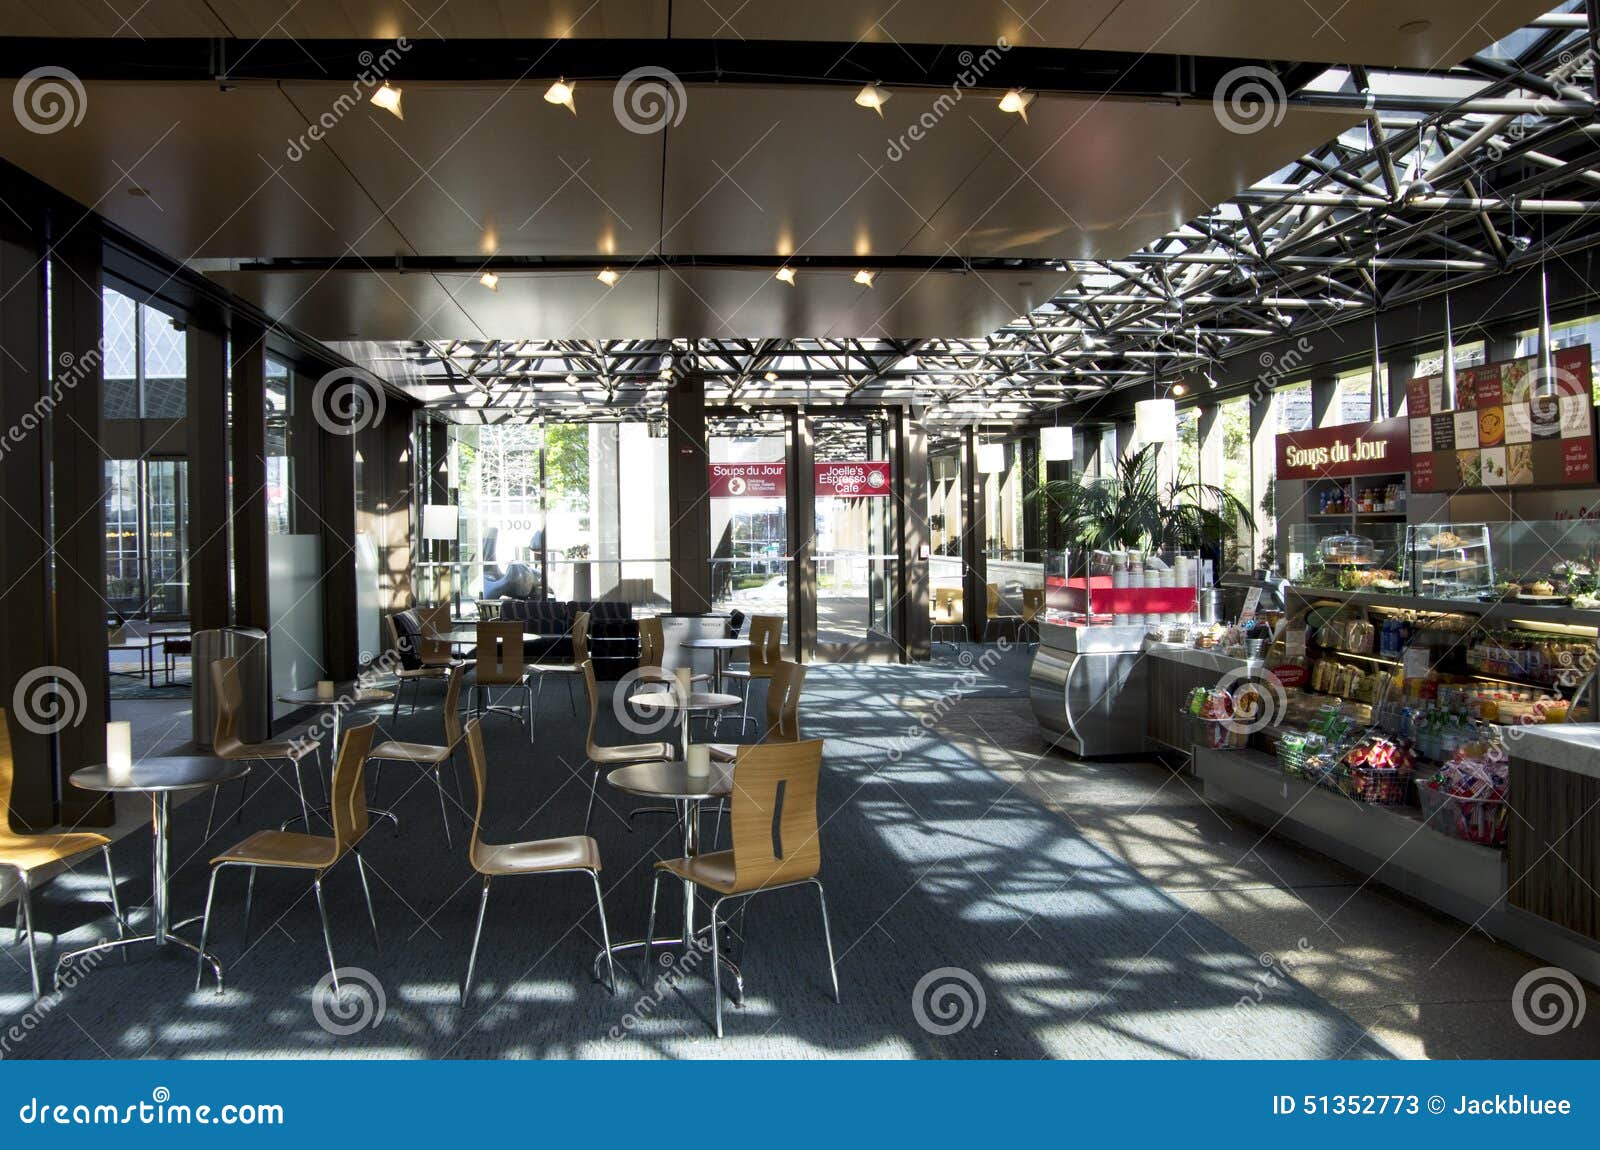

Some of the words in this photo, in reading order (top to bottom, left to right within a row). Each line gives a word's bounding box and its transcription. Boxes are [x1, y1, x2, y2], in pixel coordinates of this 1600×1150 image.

[1286, 445, 1328, 470] Soups
[1330, 440, 1350, 463] du
[1352, 437, 1387, 461] Jour
[713, 466, 745, 478] Soups
[746, 466, 759, 476] du
[761, 466, 784, 476] Jour
[826, 466, 863, 476] Joelle's
[819, 474, 866, 485] Espresso
